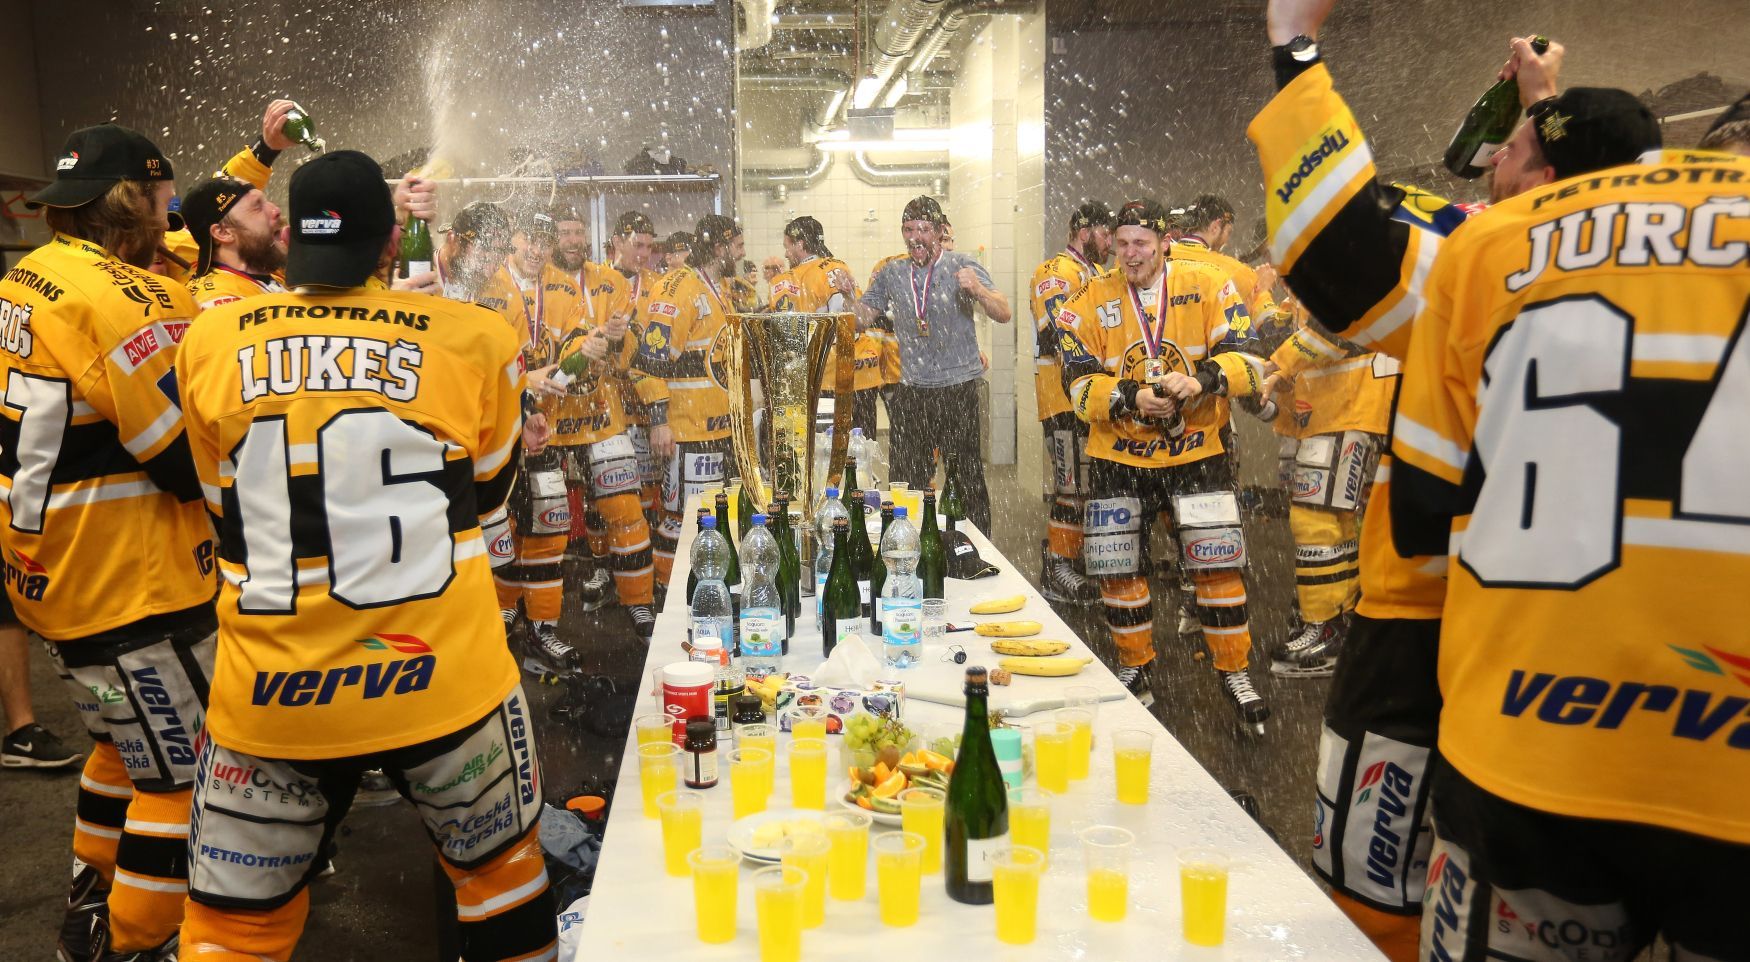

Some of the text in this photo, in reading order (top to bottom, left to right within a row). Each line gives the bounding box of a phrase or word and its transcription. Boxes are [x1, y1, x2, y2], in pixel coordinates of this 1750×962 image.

[1276, 128, 1350, 204] Tipsport
[1533, 167, 1750, 211] PETROTR
[4, 267, 65, 302] TROTRANS
[0, 297, 33, 359] ROŠ
[239, 304, 431, 332] PETROTRANS
[124, 328, 159, 366] AVE
[238, 334, 423, 404] LUKEŠ
[5, 366, 73, 535] 7
[1111, 430, 1205, 458] verva
[1345, 440, 1365, 502] verva
[229, 405, 457, 616] 16
[1085, 539, 1134, 556] Unipetrol
[1087, 557, 1132, 571] Doprava
[1194, 543, 1235, 557] Prima
[252, 654, 437, 707] verva
[131, 667, 197, 766] verva
[463, 752, 485, 772] AIR
[507, 695, 535, 806] verva
[462, 792, 511, 834] Česká
[1367, 761, 1414, 889] verva
[201, 844, 314, 868] PETROTRANS
